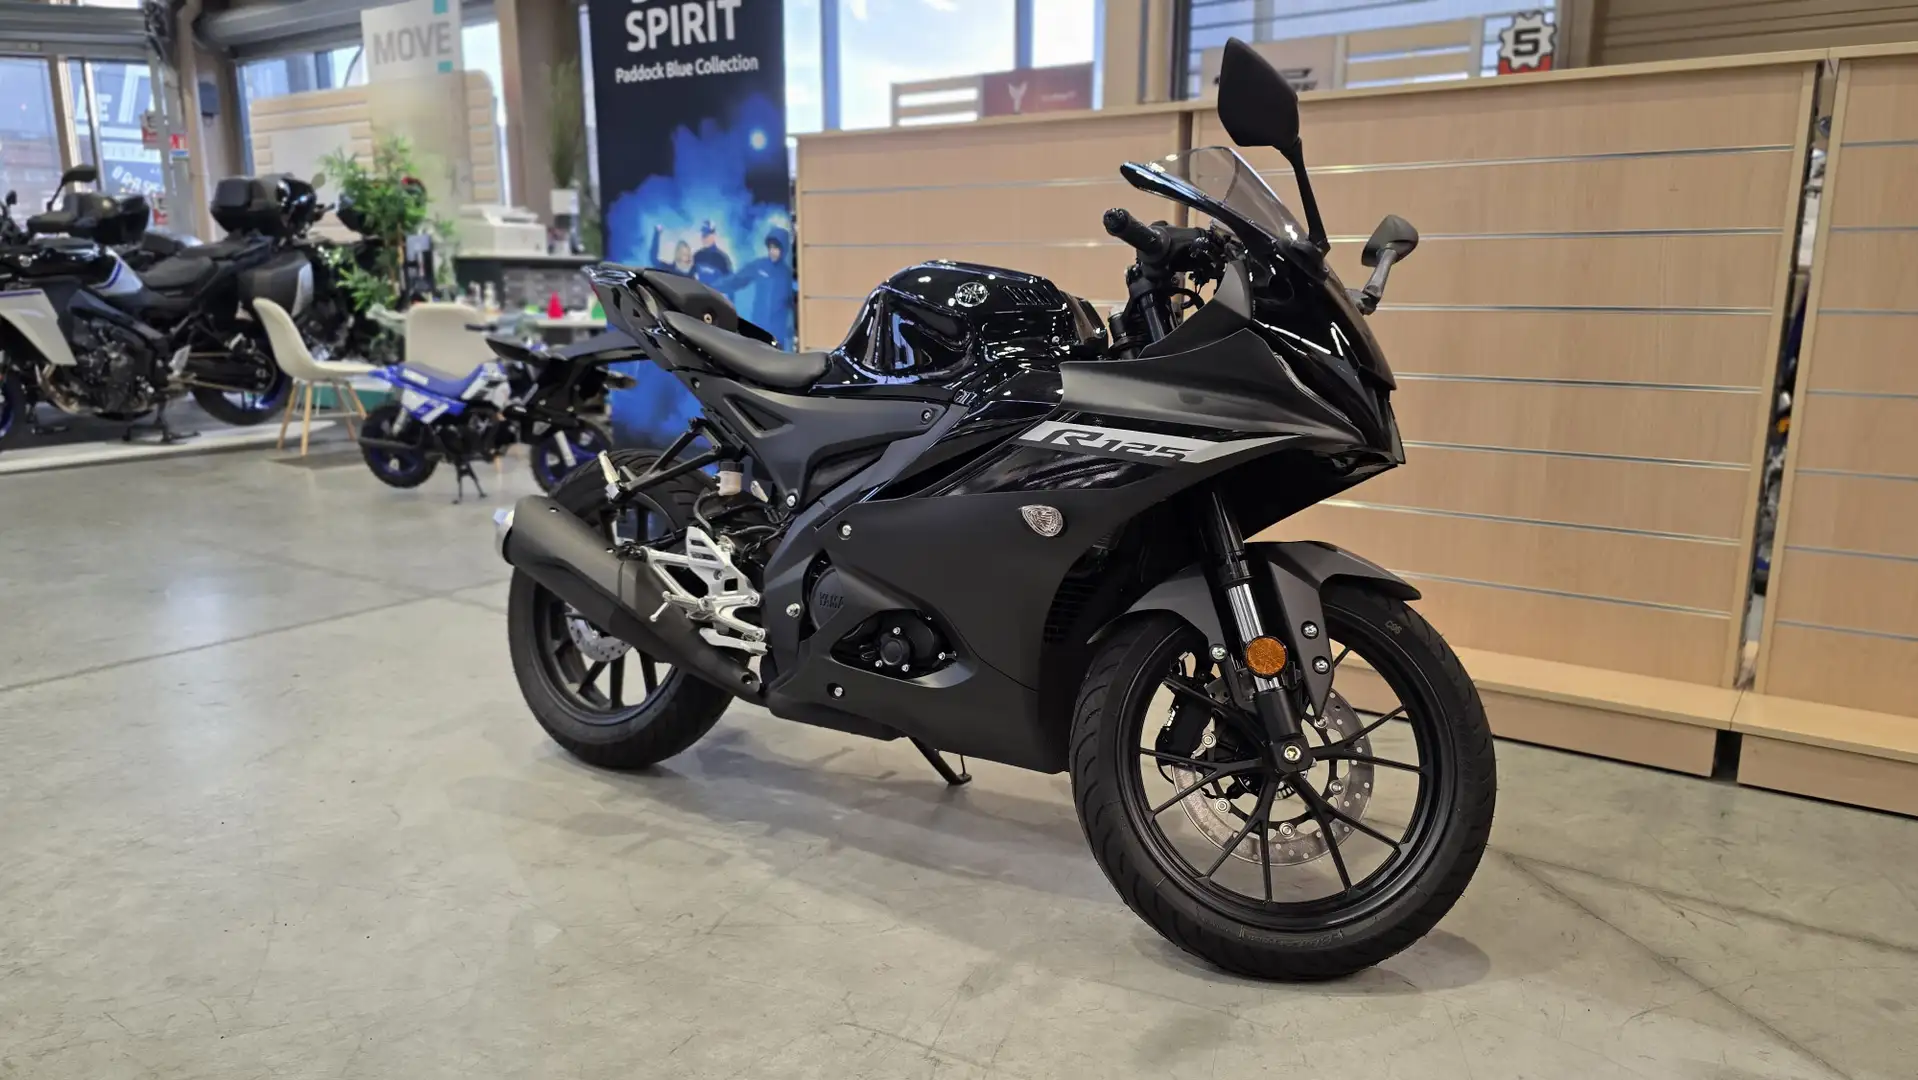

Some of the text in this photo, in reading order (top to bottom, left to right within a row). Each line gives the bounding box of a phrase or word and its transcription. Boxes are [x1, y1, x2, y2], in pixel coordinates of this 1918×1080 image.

[373, 21, 452, 65] MOVE
[625, 0, 742, 52] SPIRIT
[615, 54, 759, 84] Paddock Blue Collection
[1040, 429, 1195, 462] R125
